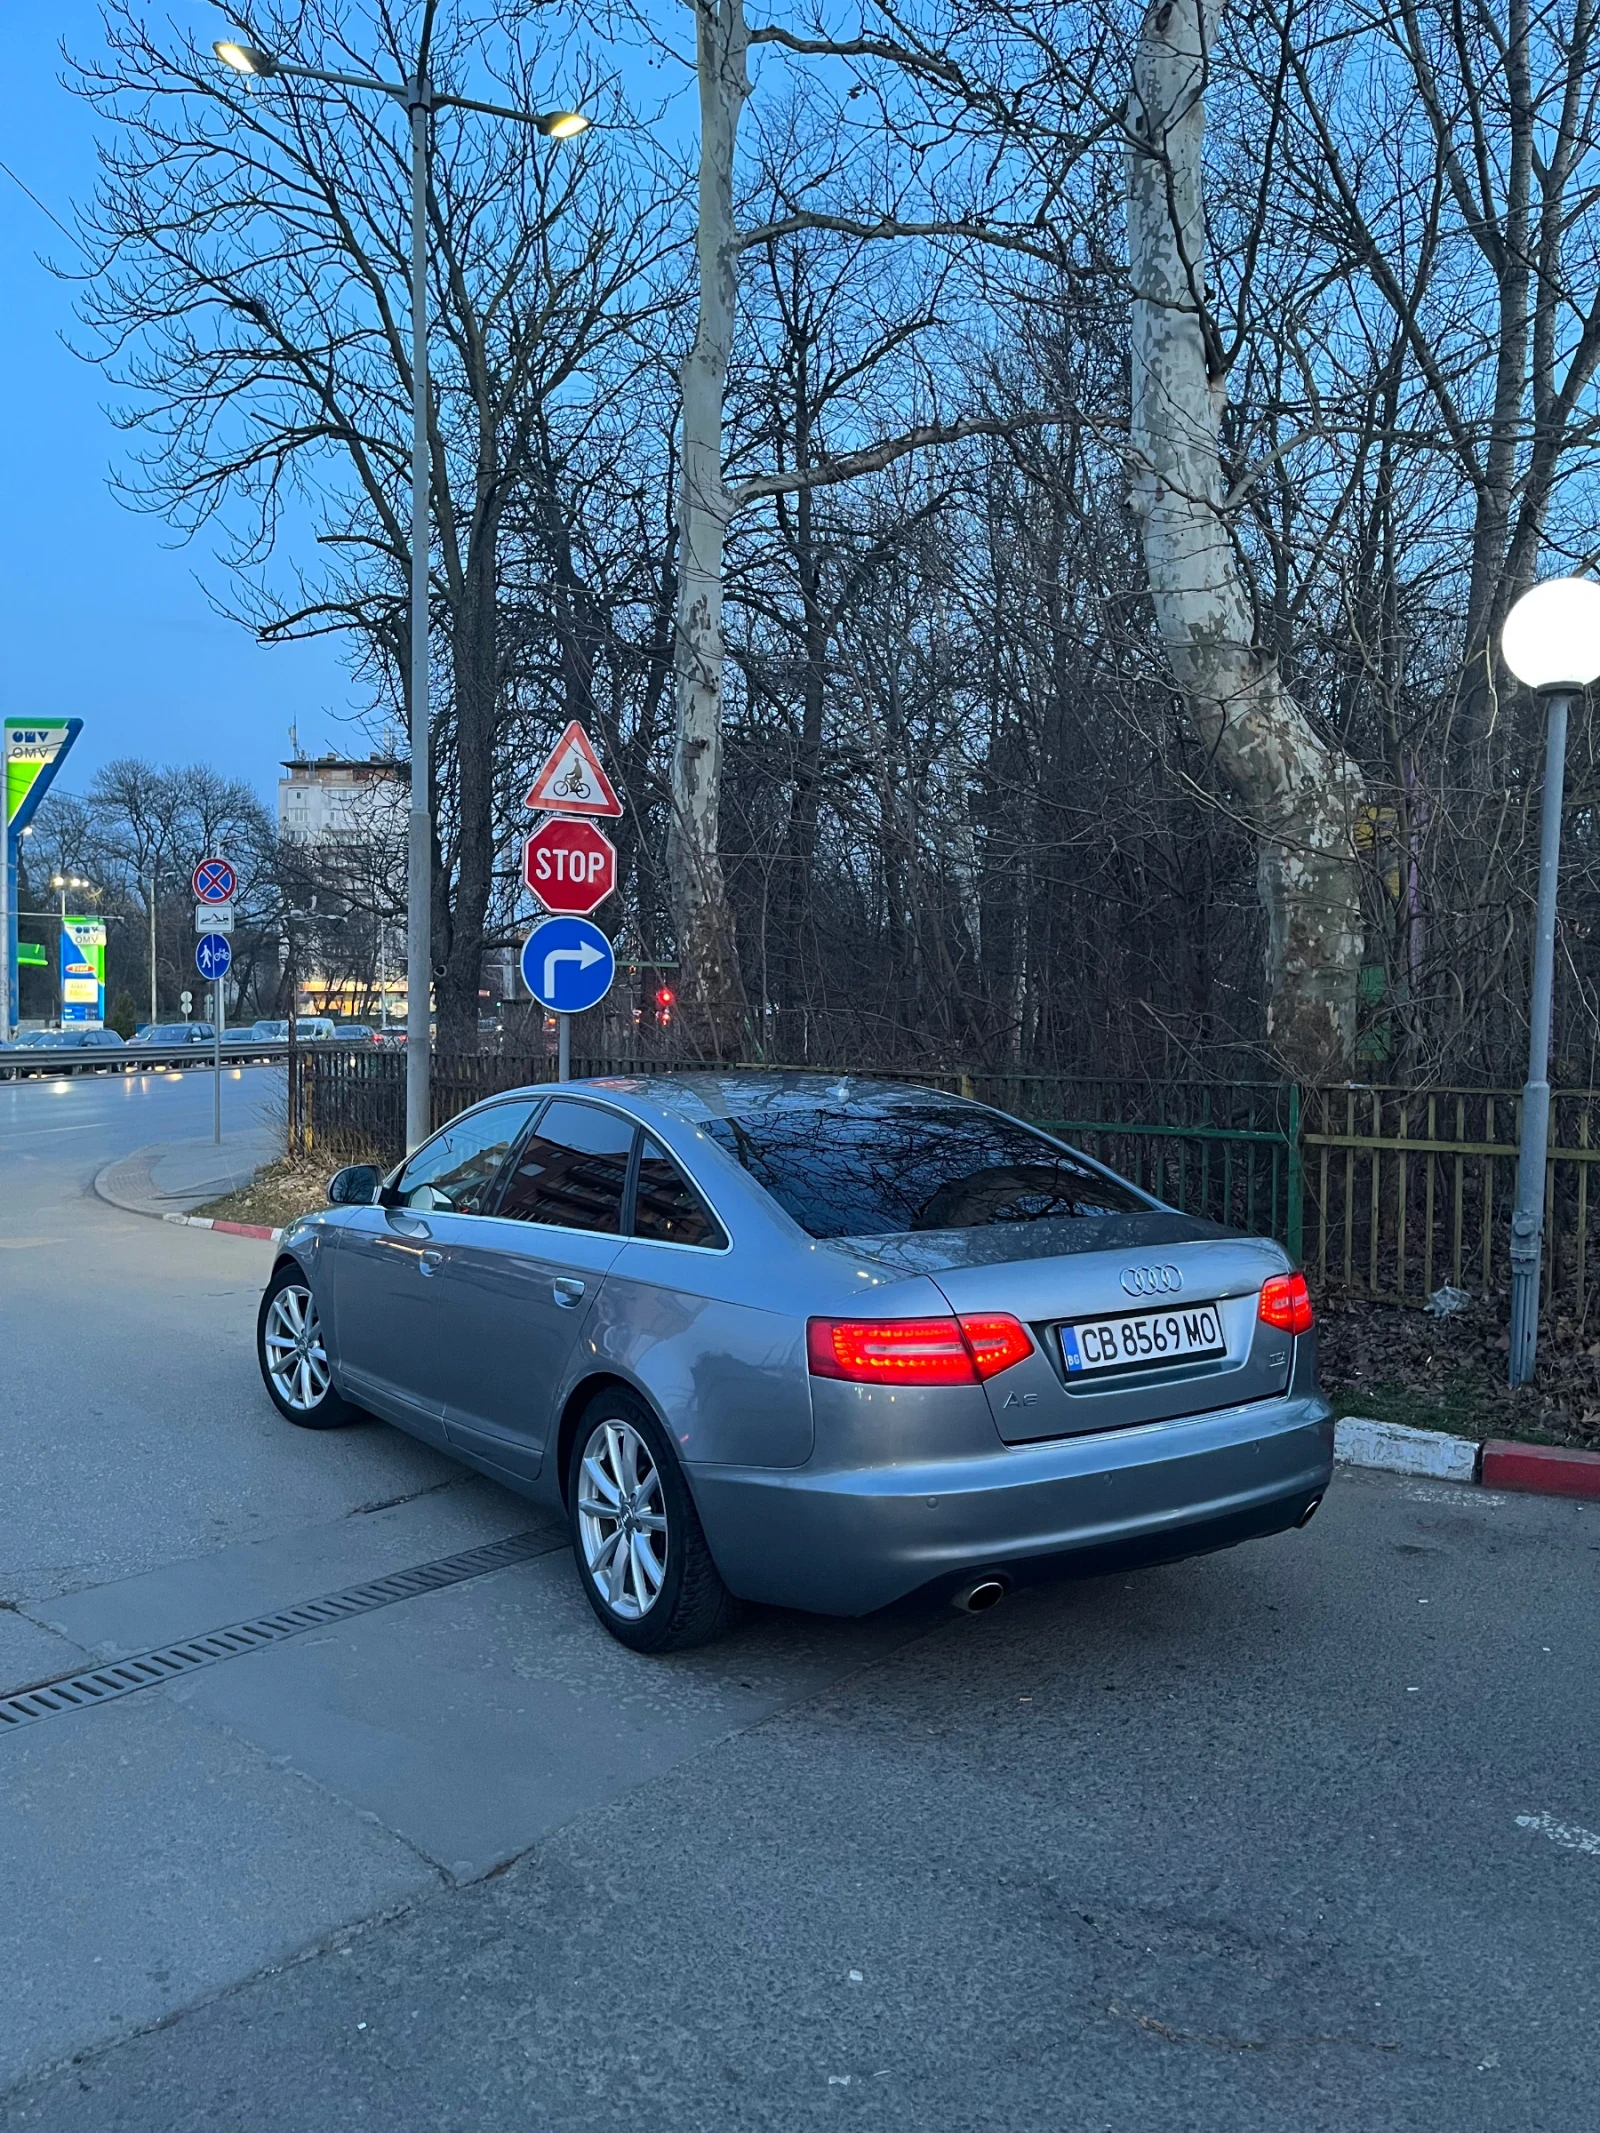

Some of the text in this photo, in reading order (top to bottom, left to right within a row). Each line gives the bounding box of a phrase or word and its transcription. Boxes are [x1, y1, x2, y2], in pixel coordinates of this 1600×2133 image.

[12, 747, 49, 759] OMV
[535, 847, 605, 883] STOP
[75, 936, 98, 944] OMV
[1081, 1312, 1216, 1362] CB 8569 MO
[1067, 1354, 1080, 1365] BG
[1003, 1391, 1038, 1409] A6
